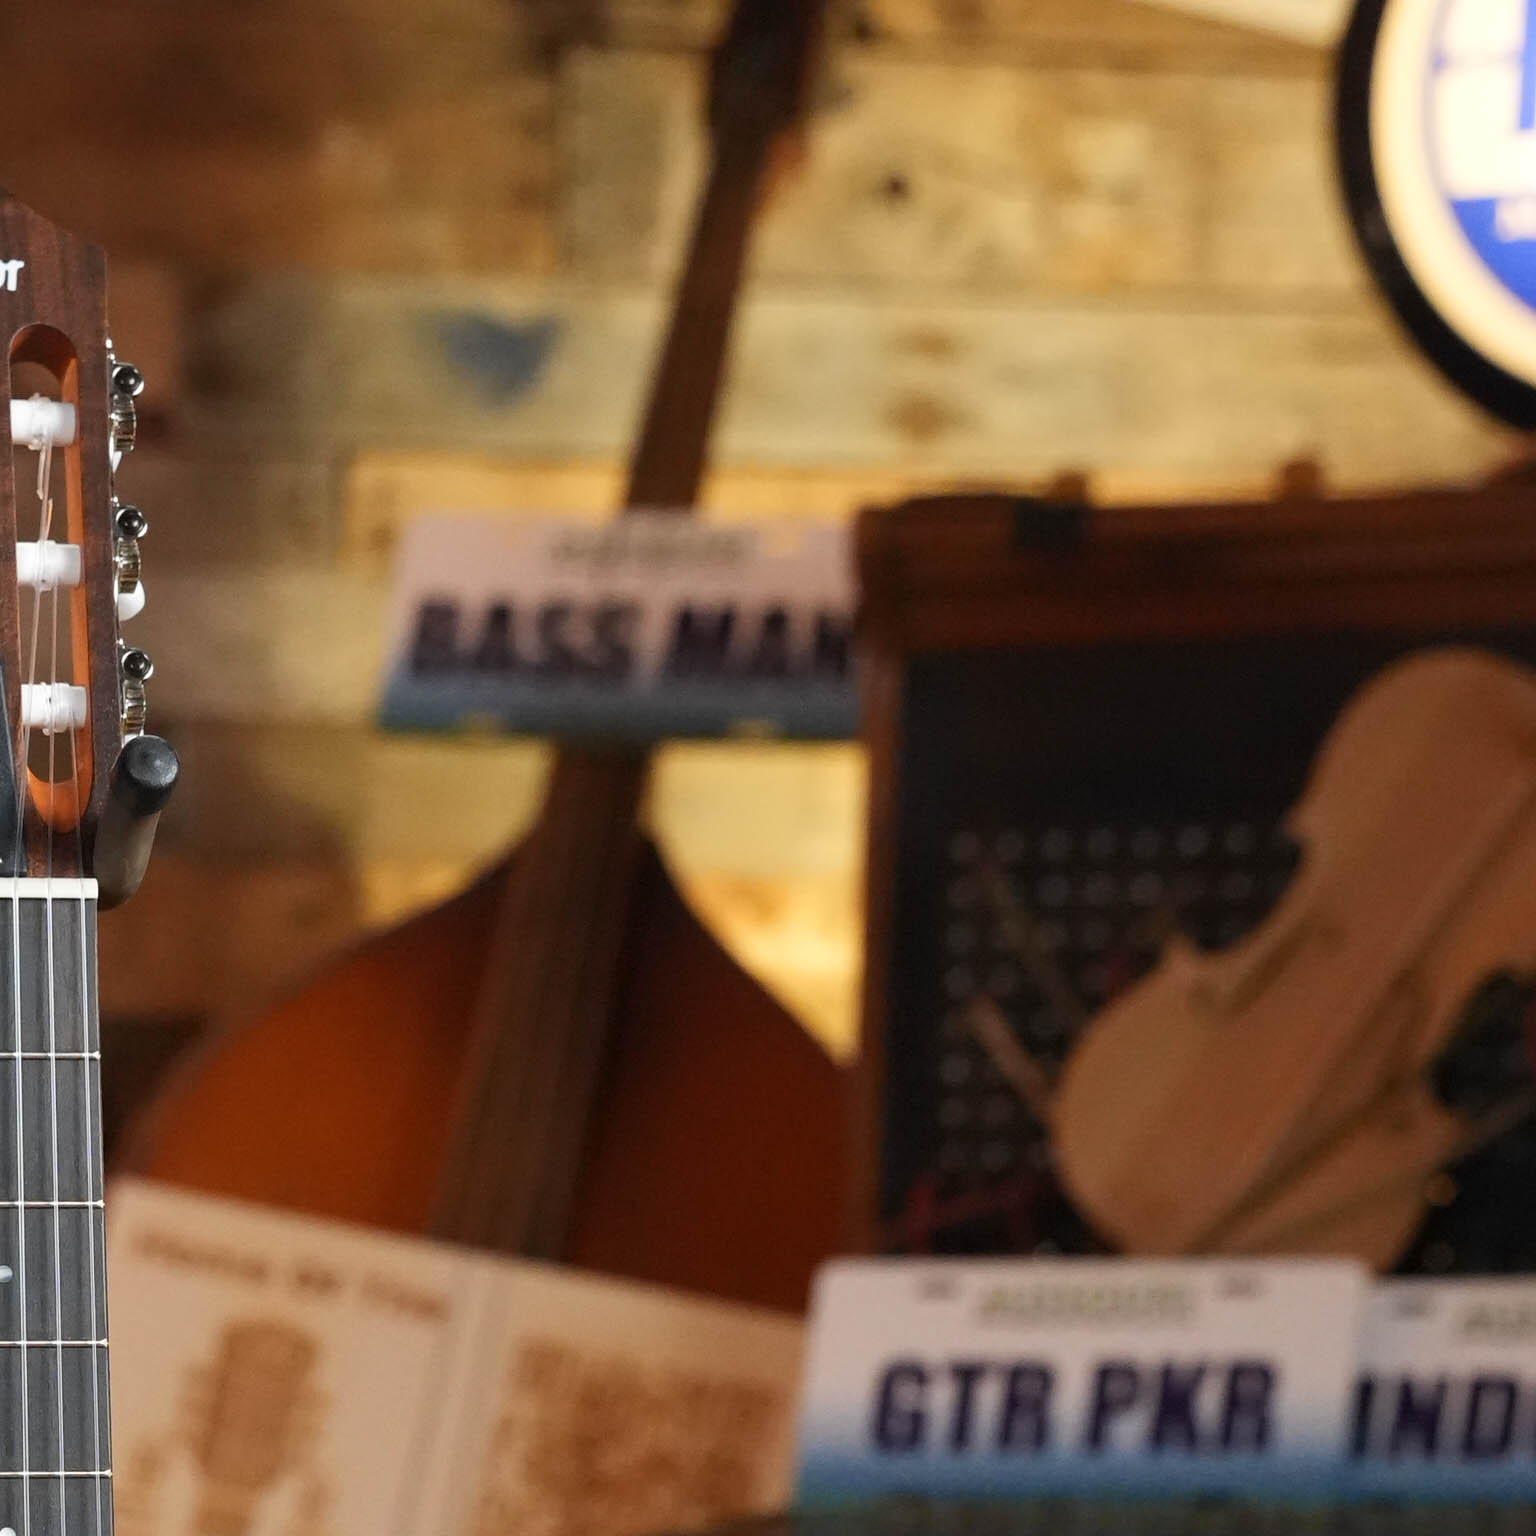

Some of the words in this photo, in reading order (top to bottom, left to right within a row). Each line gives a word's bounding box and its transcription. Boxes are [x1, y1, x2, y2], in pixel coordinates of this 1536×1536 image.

[408, 596, 644, 674] BASS
[872, 1355, 1056, 1456] GTR
[1084, 1355, 1280, 1456] PKR
[1346, 1370, 1536, 1464] IND
